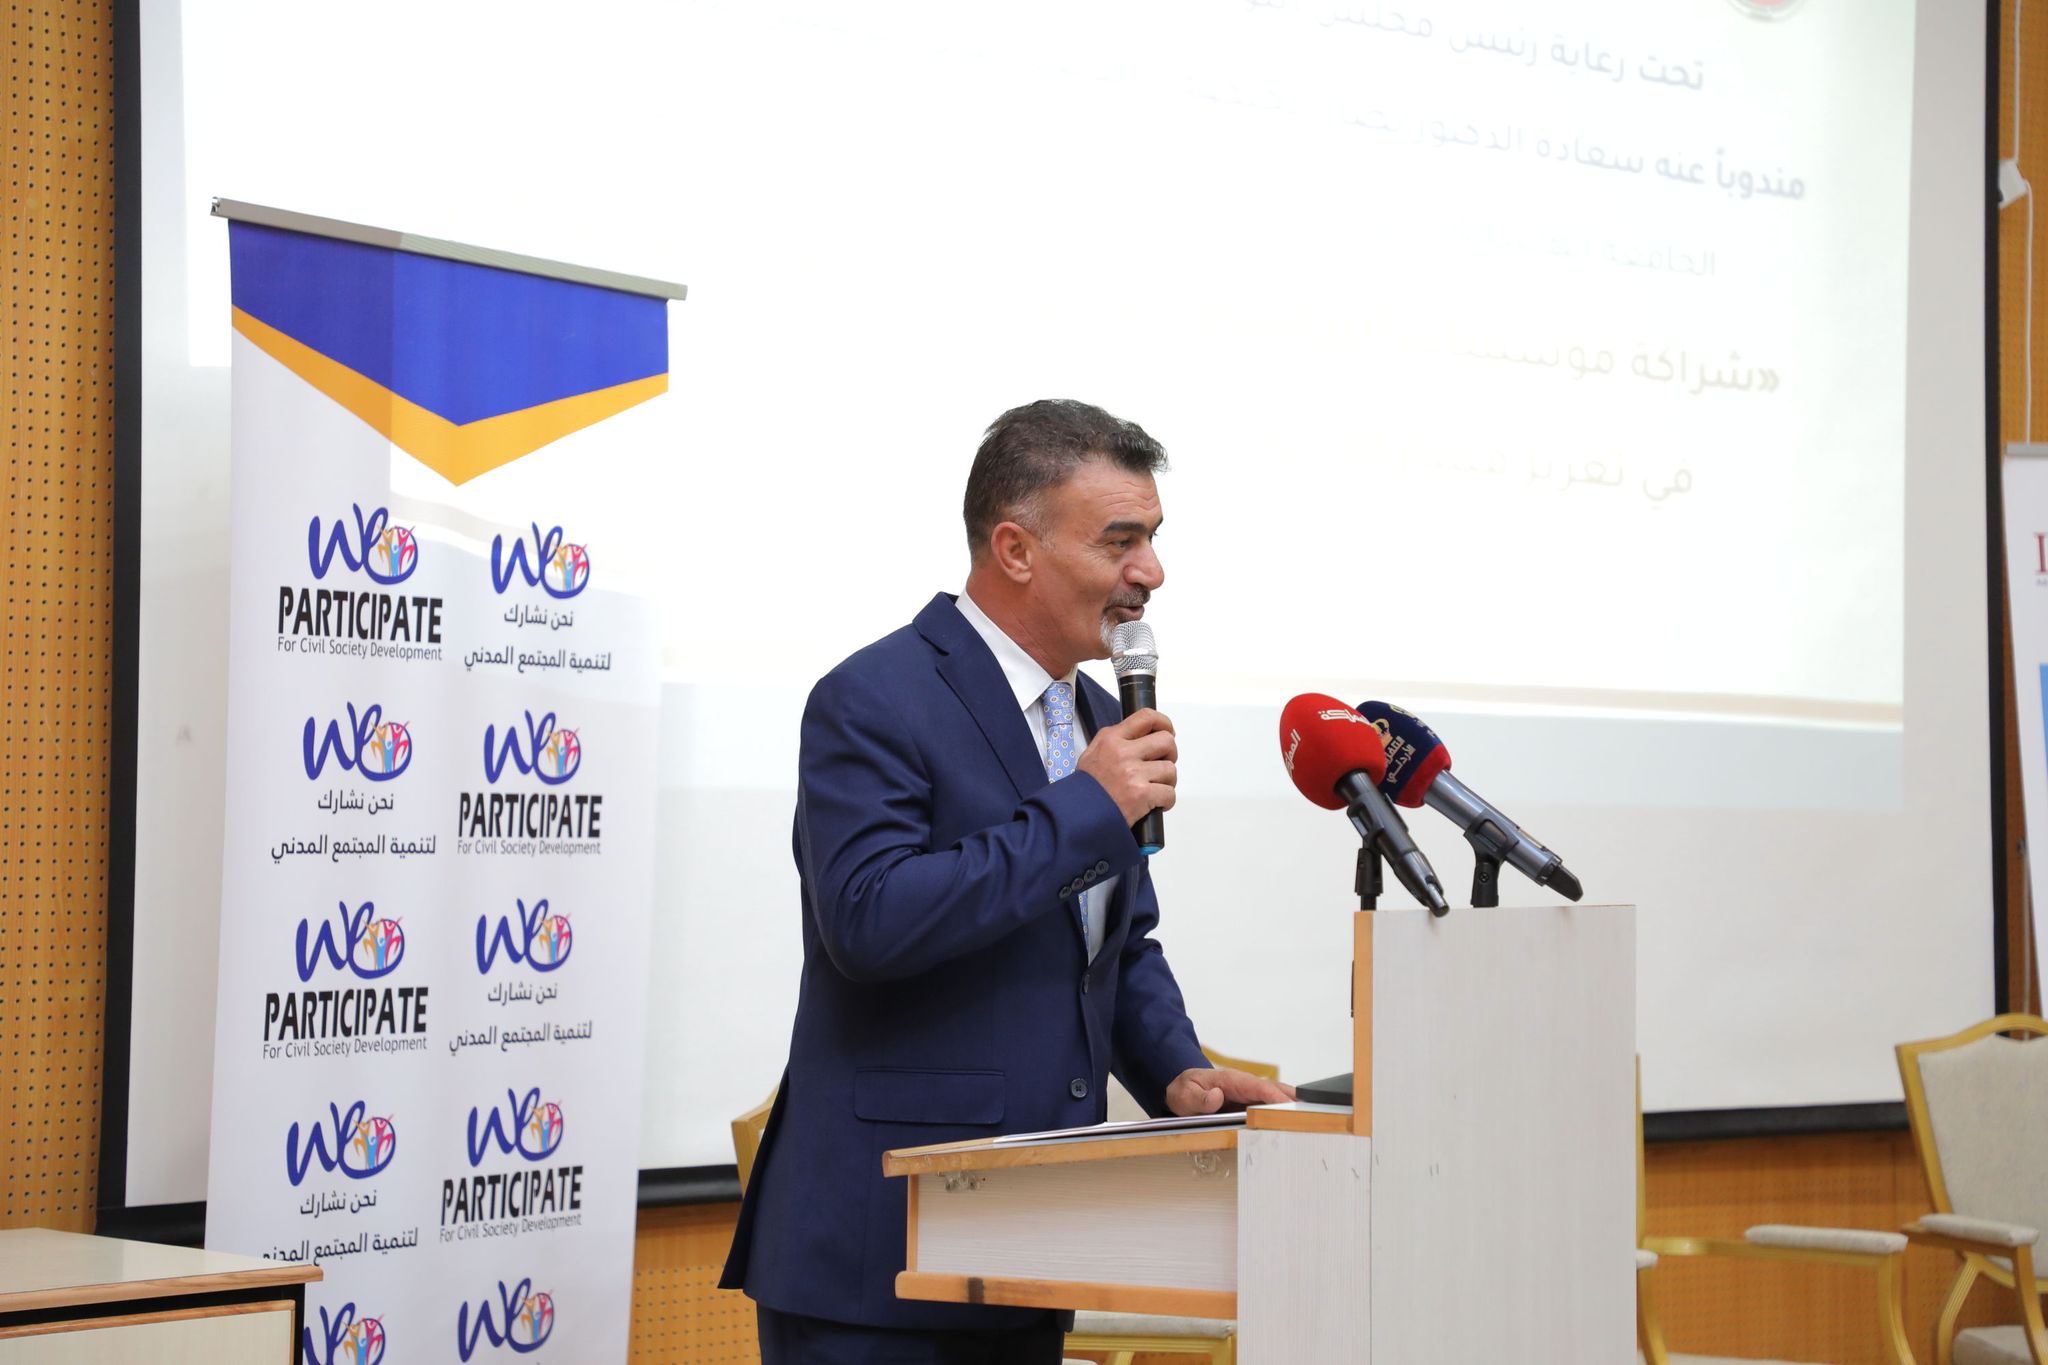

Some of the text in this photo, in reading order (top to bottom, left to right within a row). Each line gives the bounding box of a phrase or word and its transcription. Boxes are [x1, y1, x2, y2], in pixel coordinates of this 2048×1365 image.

[1551, 32, 1624, 85] رعاية
[278, 585, 443, 645] PARTICIPATE
[504, 603, 574, 630] نحن نشارك
[277, 636, 442, 662] For Civil Society Development
[464, 645, 611, 674] لتنمية المجتمع المدني
[317, 789, 394, 816] نحن نشارك
[458, 791, 603, 839] PARTICIPATE
[271, 834, 436, 864] لتنمية المجتمع المدني
[457, 840, 601, 857] For Civil Society Development
[487, 981, 558, 1006] نحن نشارك
[263, 986, 429, 1042] PARTICIPATE
[263, 1036, 427, 1059] For Civil Society Development
[449, 1020, 592, 1057] لتنمية المجتمع المدني
[300, 1189, 377, 1218] نحن نشارك
[440, 1164, 584, 1226] PARTICIPATE
[372, 1227, 418, 1254] لتنمية
[440, 1210, 581, 1242] For Civil Society Development
[310, 1232, 368, 1267] المجتمع
